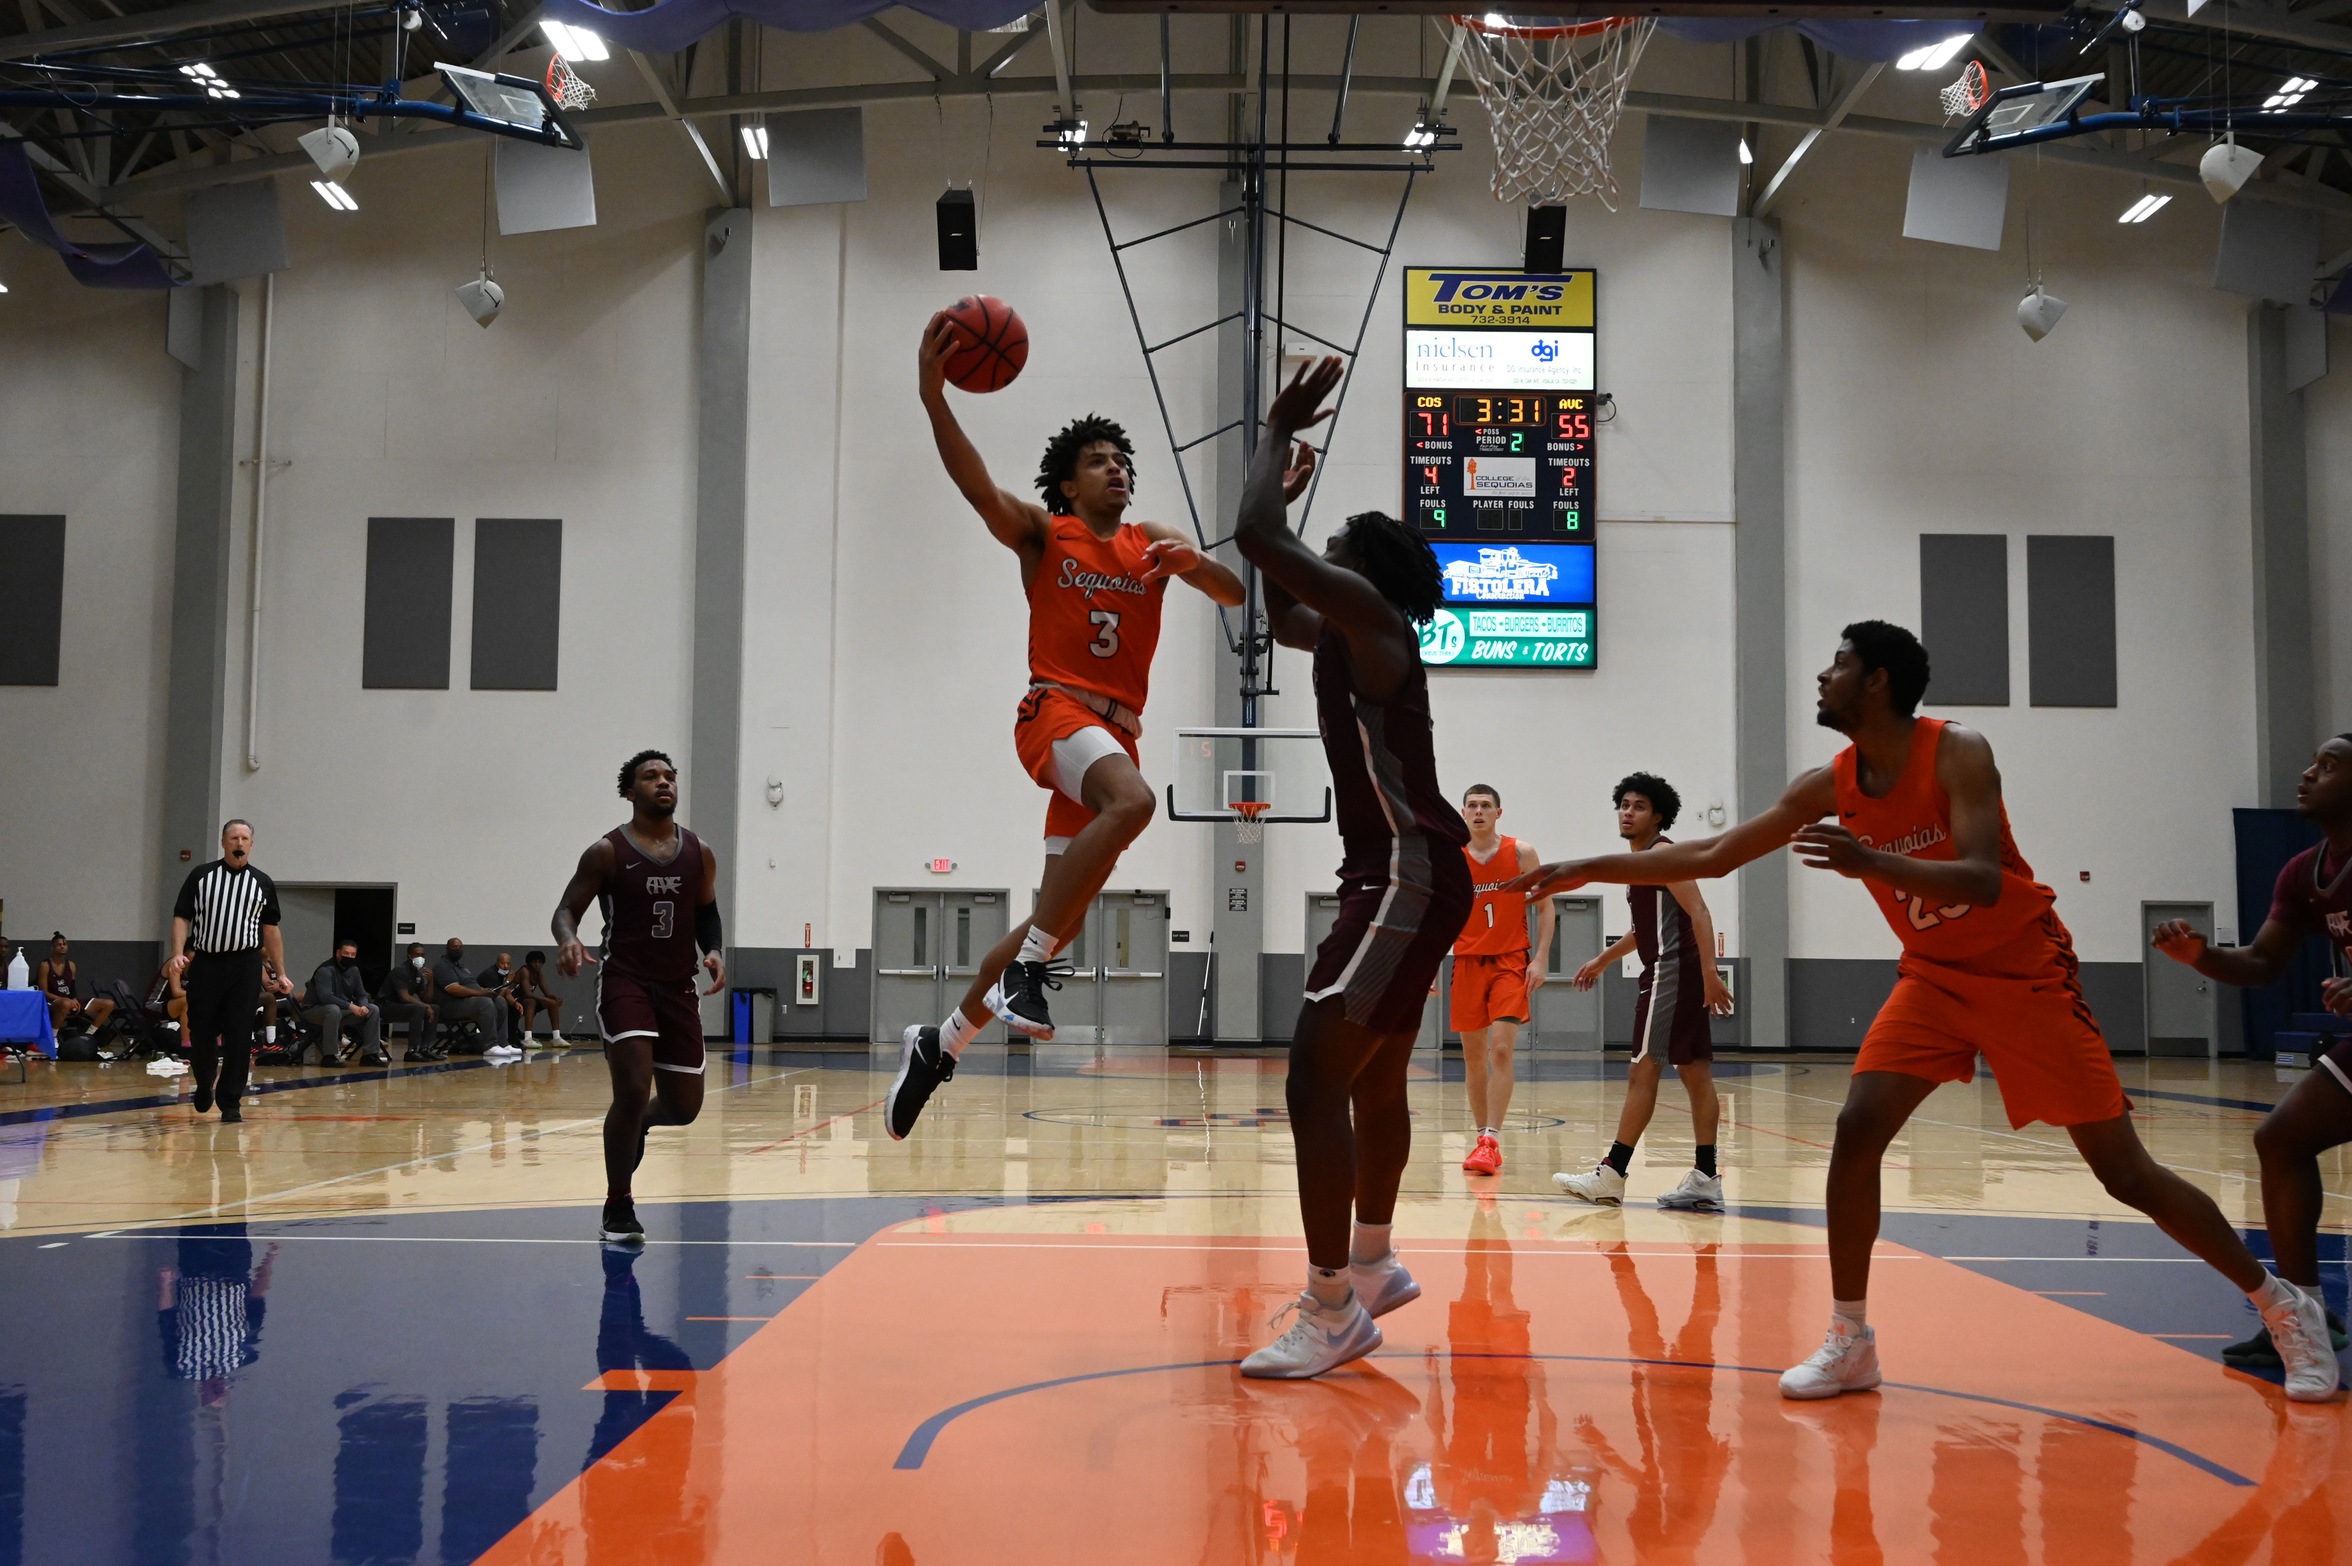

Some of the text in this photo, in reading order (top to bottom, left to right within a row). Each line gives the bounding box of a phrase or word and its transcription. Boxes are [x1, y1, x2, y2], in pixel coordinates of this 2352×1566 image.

[1428, 273, 1573, 302] TOM'S
[1438, 304, 1563, 315] BODY & PAINT
[1471, 316, 1530, 324] 732-3914
[1417, 337, 1494, 359] nielsen
[1531, 339, 1559, 363] dgi
[1415, 361, 1495, 372] Insurance
[1417, 397, 1442, 407] COS
[1477, 398, 1540, 423] 3:31
[1558, 399, 1584, 409] AVC
[1418, 412, 1448, 436] 71
[1558, 414, 1589, 438] 55
[1424, 441, 1453, 450] BONUS
[1476, 436, 1507, 444] PERIOD
[1511, 433, 1523, 452] 2
[1547, 442, 1575, 451] BONUS
[1410, 456, 1452, 465] TIMEOUTS
[1548, 457, 1590, 466] TIMEOUTS
[1424, 466, 1438, 484] 4
[1563, 467, 1575, 486] 2
[1420, 486, 1440, 494] LEFT
[1559, 488, 1579, 496] LEFT
[1420, 499, 1446, 508] FOULS
[1473, 500, 1535, 509] PLAYER FOULS
[1553, 501, 1580, 509] FOULS
[1433, 509, 1445, 528] 9
[1566, 511, 1578, 530] 8
[1057, 558, 1147, 599] Sequoias
[1473, 616, 1583, 633] TACOS BURGERS BURRITOS
[1089, 609, 1120, 658] 3
[1471, 640, 1518, 660] BUNS
[1532, 642, 1589, 662] TORTS
[934, 859, 950, 871] EXIT
[651, 901, 674, 938] 3
[1483, 902, 1494, 928] 1
